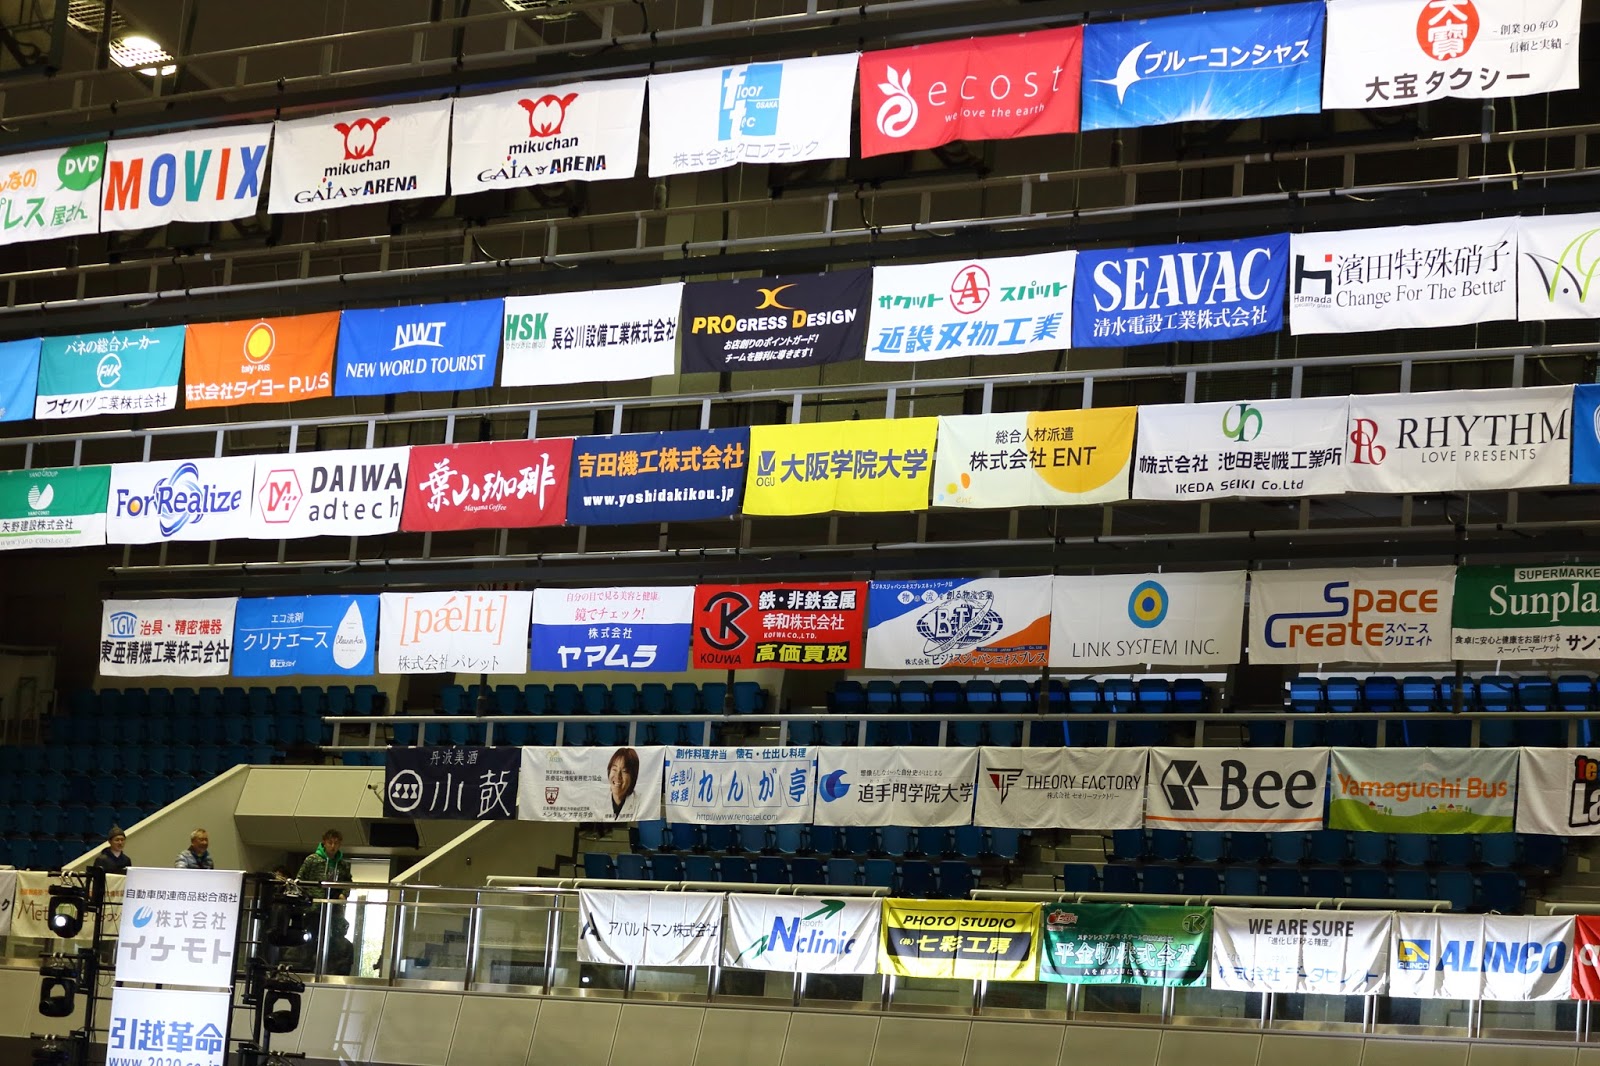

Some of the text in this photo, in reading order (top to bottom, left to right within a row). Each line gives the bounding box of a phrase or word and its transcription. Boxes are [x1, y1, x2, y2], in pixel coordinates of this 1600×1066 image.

[1145, 38, 1309, 76] ブルーコンシャス
[926, 64, 1065, 107] ecost
[1366, 67, 1530, 103] 大宝タクシー
[756, 100, 778, 109] OSAKA
[991, 105, 1013, 117] the
[1015, 104, 1045, 117] earth
[508, 136, 578, 156] mikuchan
[65, 154, 100, 177] DVD
[323, 158, 391, 178] mikuchan
[549, 155, 607, 174] ARENA
[0, 168, 37, 191] なの
[104, 145, 267, 212] MOVIX
[362, 175, 418, 196] ARENA
[1093, 247, 1271, 313] SEAVAC
[878, 291, 944, 310] サクット
[1000, 280, 1069, 302] スパット
[1293, 294, 1332, 304] Hamada
[1335, 278, 1507, 309] Change For The Better
[505, 312, 549, 341] HSK
[1093, 304, 1268, 337] 清水電設工業株式会社
[394, 322, 446, 347] NWT
[551, 317, 677, 350] 長谷川設備工業株式会社
[64, 335, 161, 356] バネの総合メーカー
[345, 354, 486, 378] NEW WORLD TOURIST
[995, 426, 1075, 444] 総合人材派遣
[1394, 408, 1570, 450] RHYTHM
[577, 443, 745, 479] 吉田機工株式会社
[780, 448, 928, 484] 大阪学院大学
[969, 446, 1098, 472] 株式会社 ENT
[1139, 454, 1209, 474] 株式会社
[1421, 448, 1537, 464] LOVE PRESENTS
[310, 462, 403, 494] DAIWA
[418, 452, 556, 513] 葉山珈琲
[755, 474, 776, 487] OGU
[1176, 481, 1215, 494] IKEDA
[1220, 479, 1256, 491] SEIKI
[583, 485, 735, 508] www.yoshidakikou.jp
[308, 495, 400, 522] adtech
[1, 518, 74, 533] 矢野建設株式会社
[758, 589, 856, 610] 鉄・非鉄金属
[110, 614, 137, 636] TGW
[139, 618, 223, 636] 治具・精密機器
[271, 611, 305, 623] エコ洗剤
[762, 613, 845, 631] 幸和株式会社
[587, 627, 633, 640] 株式会社
[1385, 623, 1429, 634] スペース
[243, 632, 329, 652] クリナエース
[1071, 638, 1220, 658] LINK SYSTEM INC.
[1384, 635, 1433, 647] クリエイト
[1454, 633, 1561, 645] 食卓に安心と健康をお届けする
[1497, 644, 1560, 654] スーパーマーケット
[101, 638, 230, 665] 東亜精機工業株式会社
[557, 644, 659, 669] ヤマムラ
[700, 653, 742, 665] KOUWA
[755, 643, 848, 663] 高価買取
[429, 749, 478, 766] 丹波美酒
[676, 748, 727, 760] 創作料理弁当
[1025, 774, 1142, 790] THEORY FACTORY
[1220, 759, 1317, 811] Bee
[1337, 773, 1508, 802] Yamaguchi Bus
[857, 782, 974, 804] 追手門学院大学
[1047, 791, 1070, 800] 株式会社
[126, 888, 238, 903] 自動車関連商品総合商社
[155, 909, 227, 930] 株式会社
[608, 920, 719, 939] アパルトマン株式会社
[902, 914, 1017, 929] PHOTO STUDIO
[1248, 918, 1355, 938] WE ARE SURE
[1398, 962, 1430, 971] ALINCO
[1435, 940, 1567, 974] ALINCO
[111, 1017, 224, 1055] 引越革命
